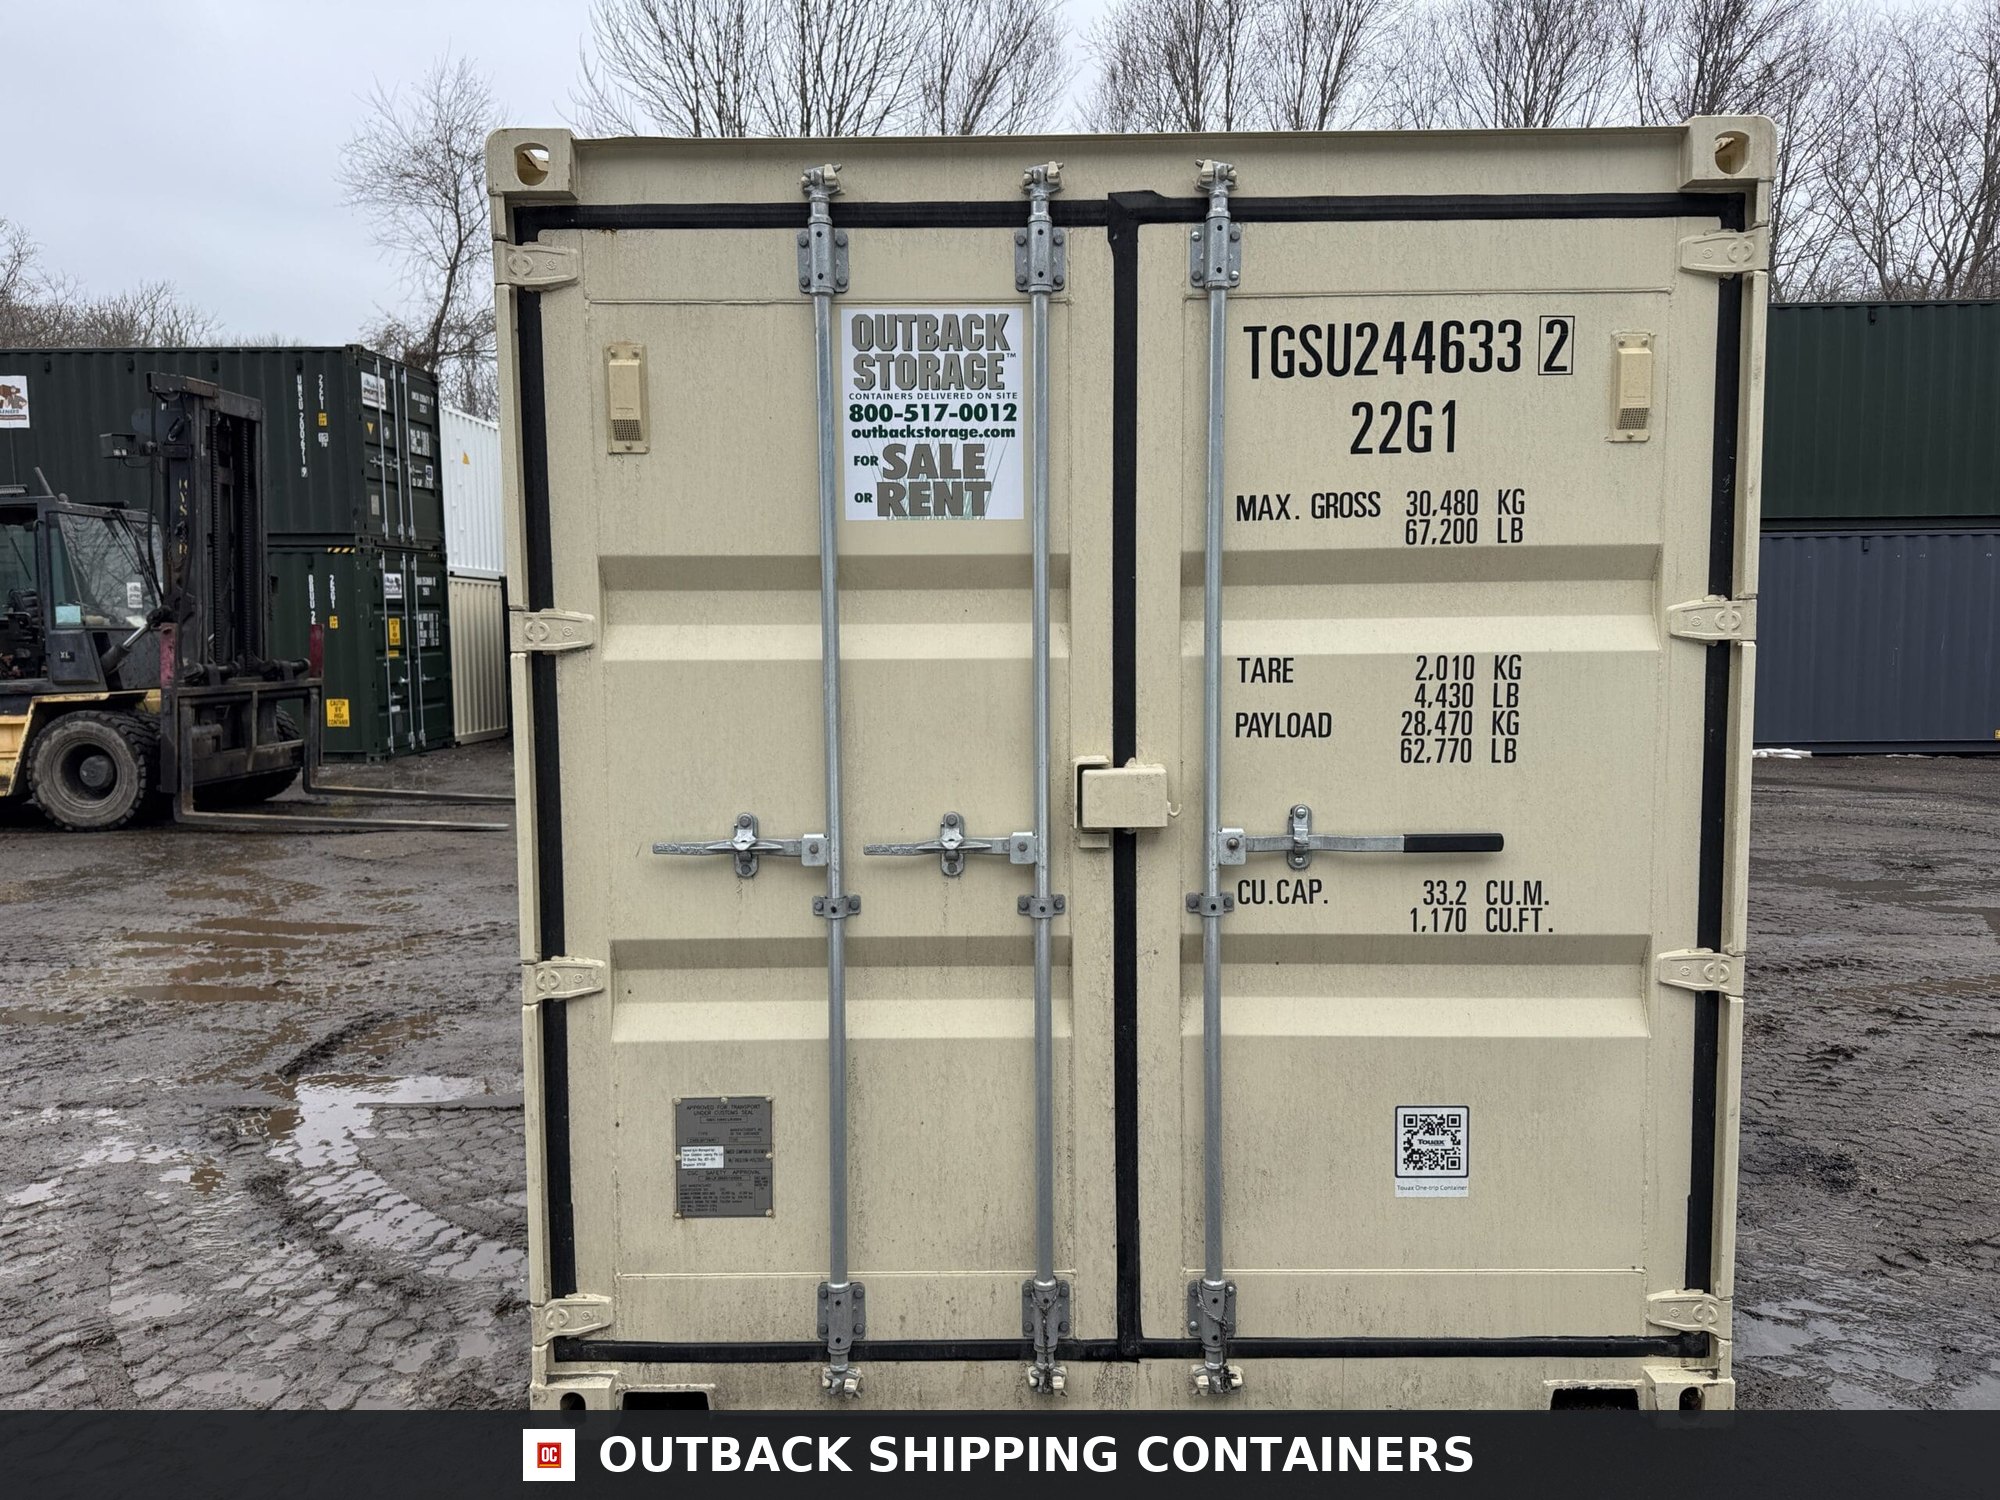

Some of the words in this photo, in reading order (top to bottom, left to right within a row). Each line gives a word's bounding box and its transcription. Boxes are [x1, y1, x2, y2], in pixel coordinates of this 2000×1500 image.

[851, 313, 1011, 352] OUTBACK
[1243, 319, 1522, 379] TGSU244633
[1543, 319, 1569, 372] 2
[853, 353, 1005, 391] STORAGE
[848, 392, 914, 401] CONTAINERS
[917, 392, 973, 400] DELIVERED
[977, 392, 993, 400] ON
[996, 391, 1018, 400] SITE
[849, 403, 1017, 422] 800-517-0012
[1350, 399, 1456, 455] 22G1
[851, 425, 1016, 441] outbackstorage.com
[853, 455, 879, 467] FOR
[882, 443, 986, 480] SALE
[854, 492, 873, 504] OR
[876, 481, 992, 517] RENT
[1236, 493, 1301, 522] MAX.
[1310, 490, 1382, 519] GROSS
[1405, 488, 1479, 518] 30,480
[1497, 488, 1526, 516] KG
[1405, 517, 1478, 546] 67,200
[1496, 516, 1524, 544] LB
[1236, 656, 1295, 684] TARE
[1415, 654, 1475, 682] 2,010
[1494, 654, 1522, 681] KG
[1413, 682, 1475, 709] 4,430
[1492, 681, 1520, 709] LB
[1234, 711, 1332, 739] PAYLOAD
[1400, 709, 1473, 738] 28,470
[1491, 709, 1520, 737] KG
[1400, 737, 1472, 765] 62,770
[1490, 737, 1517, 764] LB
[1237, 878, 1329, 905] CU.CAP.
[1422, 879, 1468, 906] 33.2
[1485, 880, 1550, 906] CU.M.
[1409, 907, 1468, 933] 1,170
[1485, 907, 1554, 933] CU.FT.
